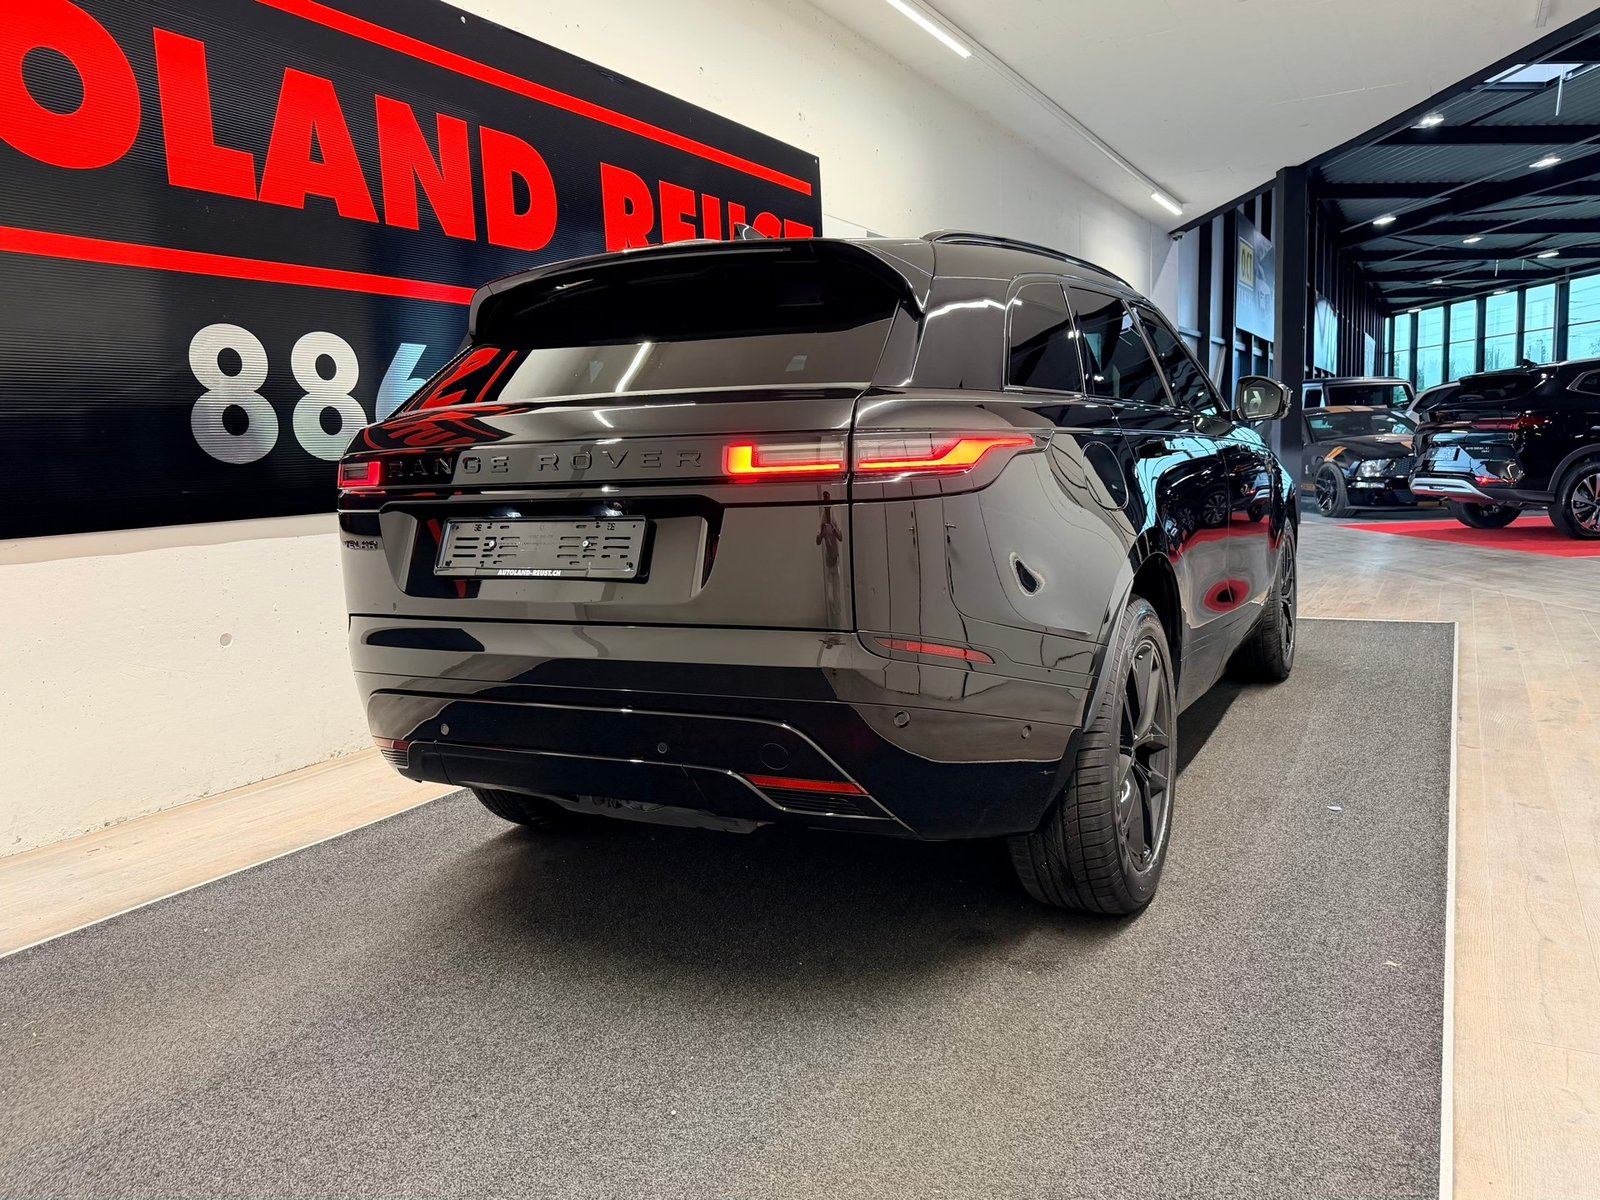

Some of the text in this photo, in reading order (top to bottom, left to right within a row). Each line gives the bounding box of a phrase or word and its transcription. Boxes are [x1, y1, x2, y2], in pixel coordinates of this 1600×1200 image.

[0, 0, 558, 251] OLAND
[387, 449, 702, 478] RANGE ROVER
[496, 569, 562, 577] AUTOLAND-REUST.CH
